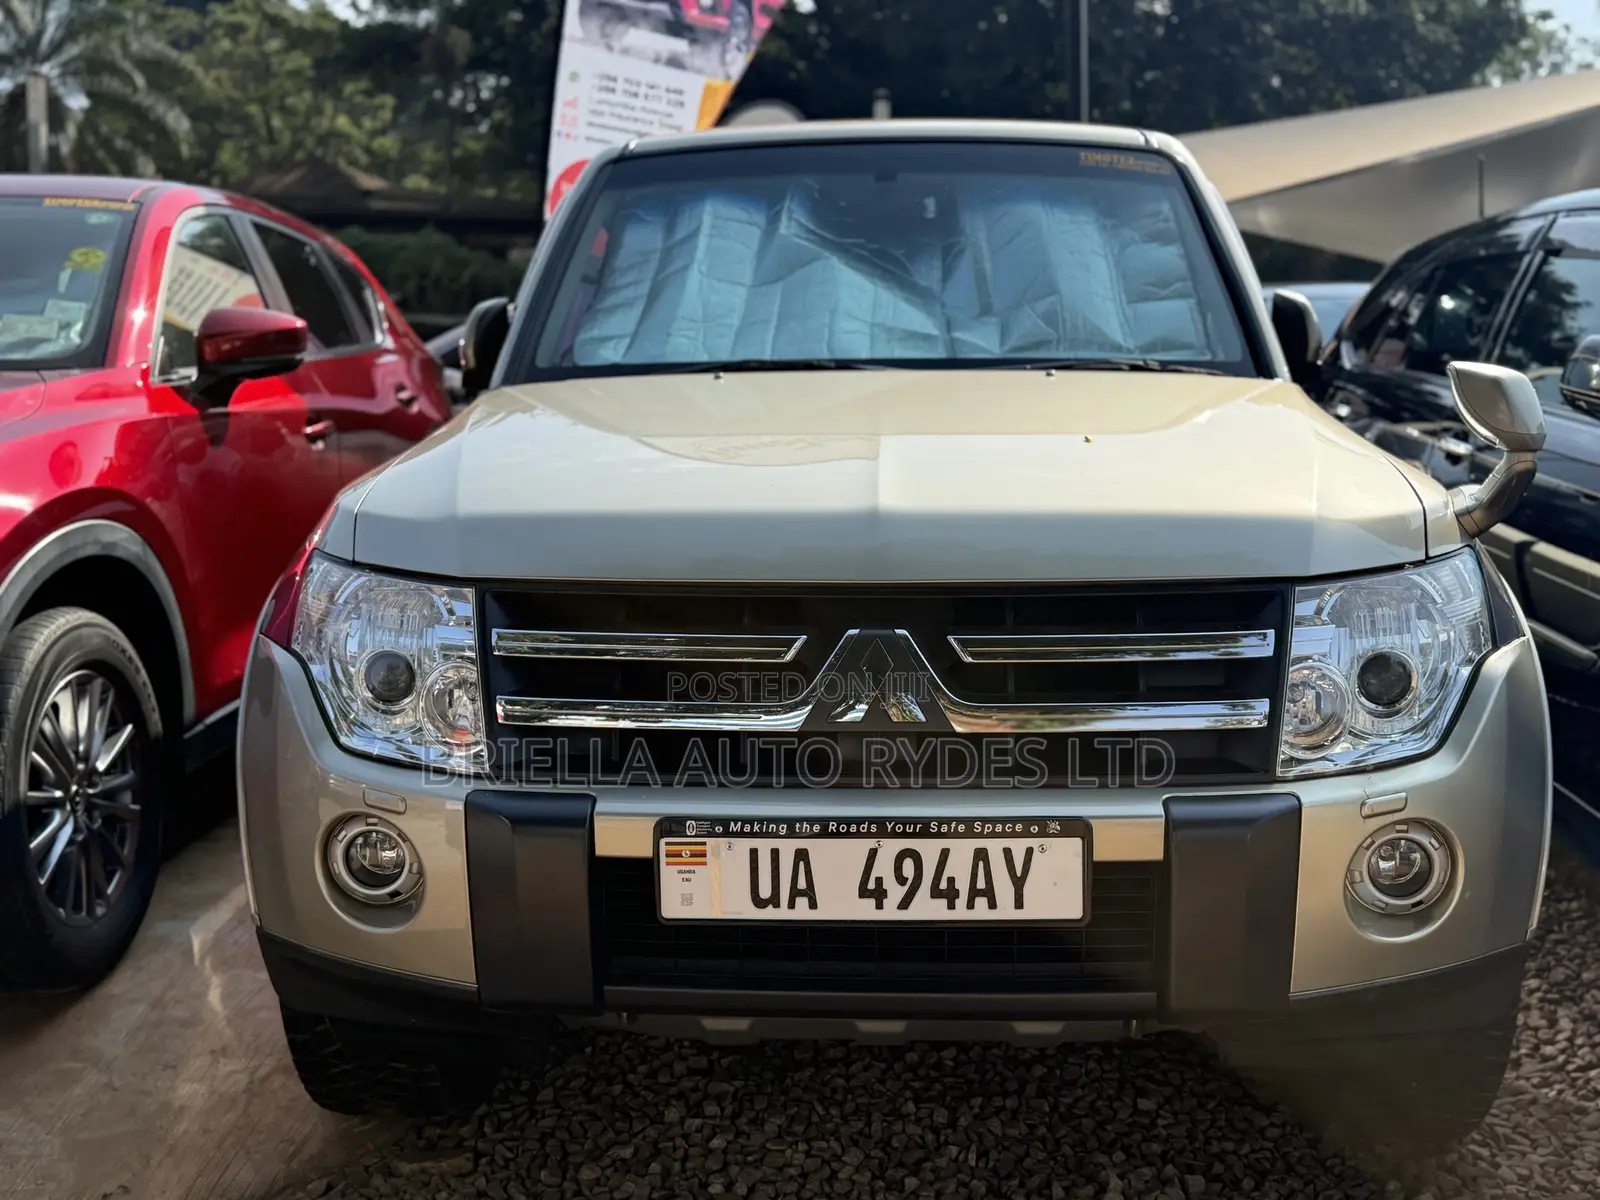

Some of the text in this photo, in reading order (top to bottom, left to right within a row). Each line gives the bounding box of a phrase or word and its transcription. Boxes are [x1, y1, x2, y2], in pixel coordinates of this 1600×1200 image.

[729, 821, 1023, 835] Making the Roads Your Safe Space
[749, 846, 1035, 911] UA 494AY
